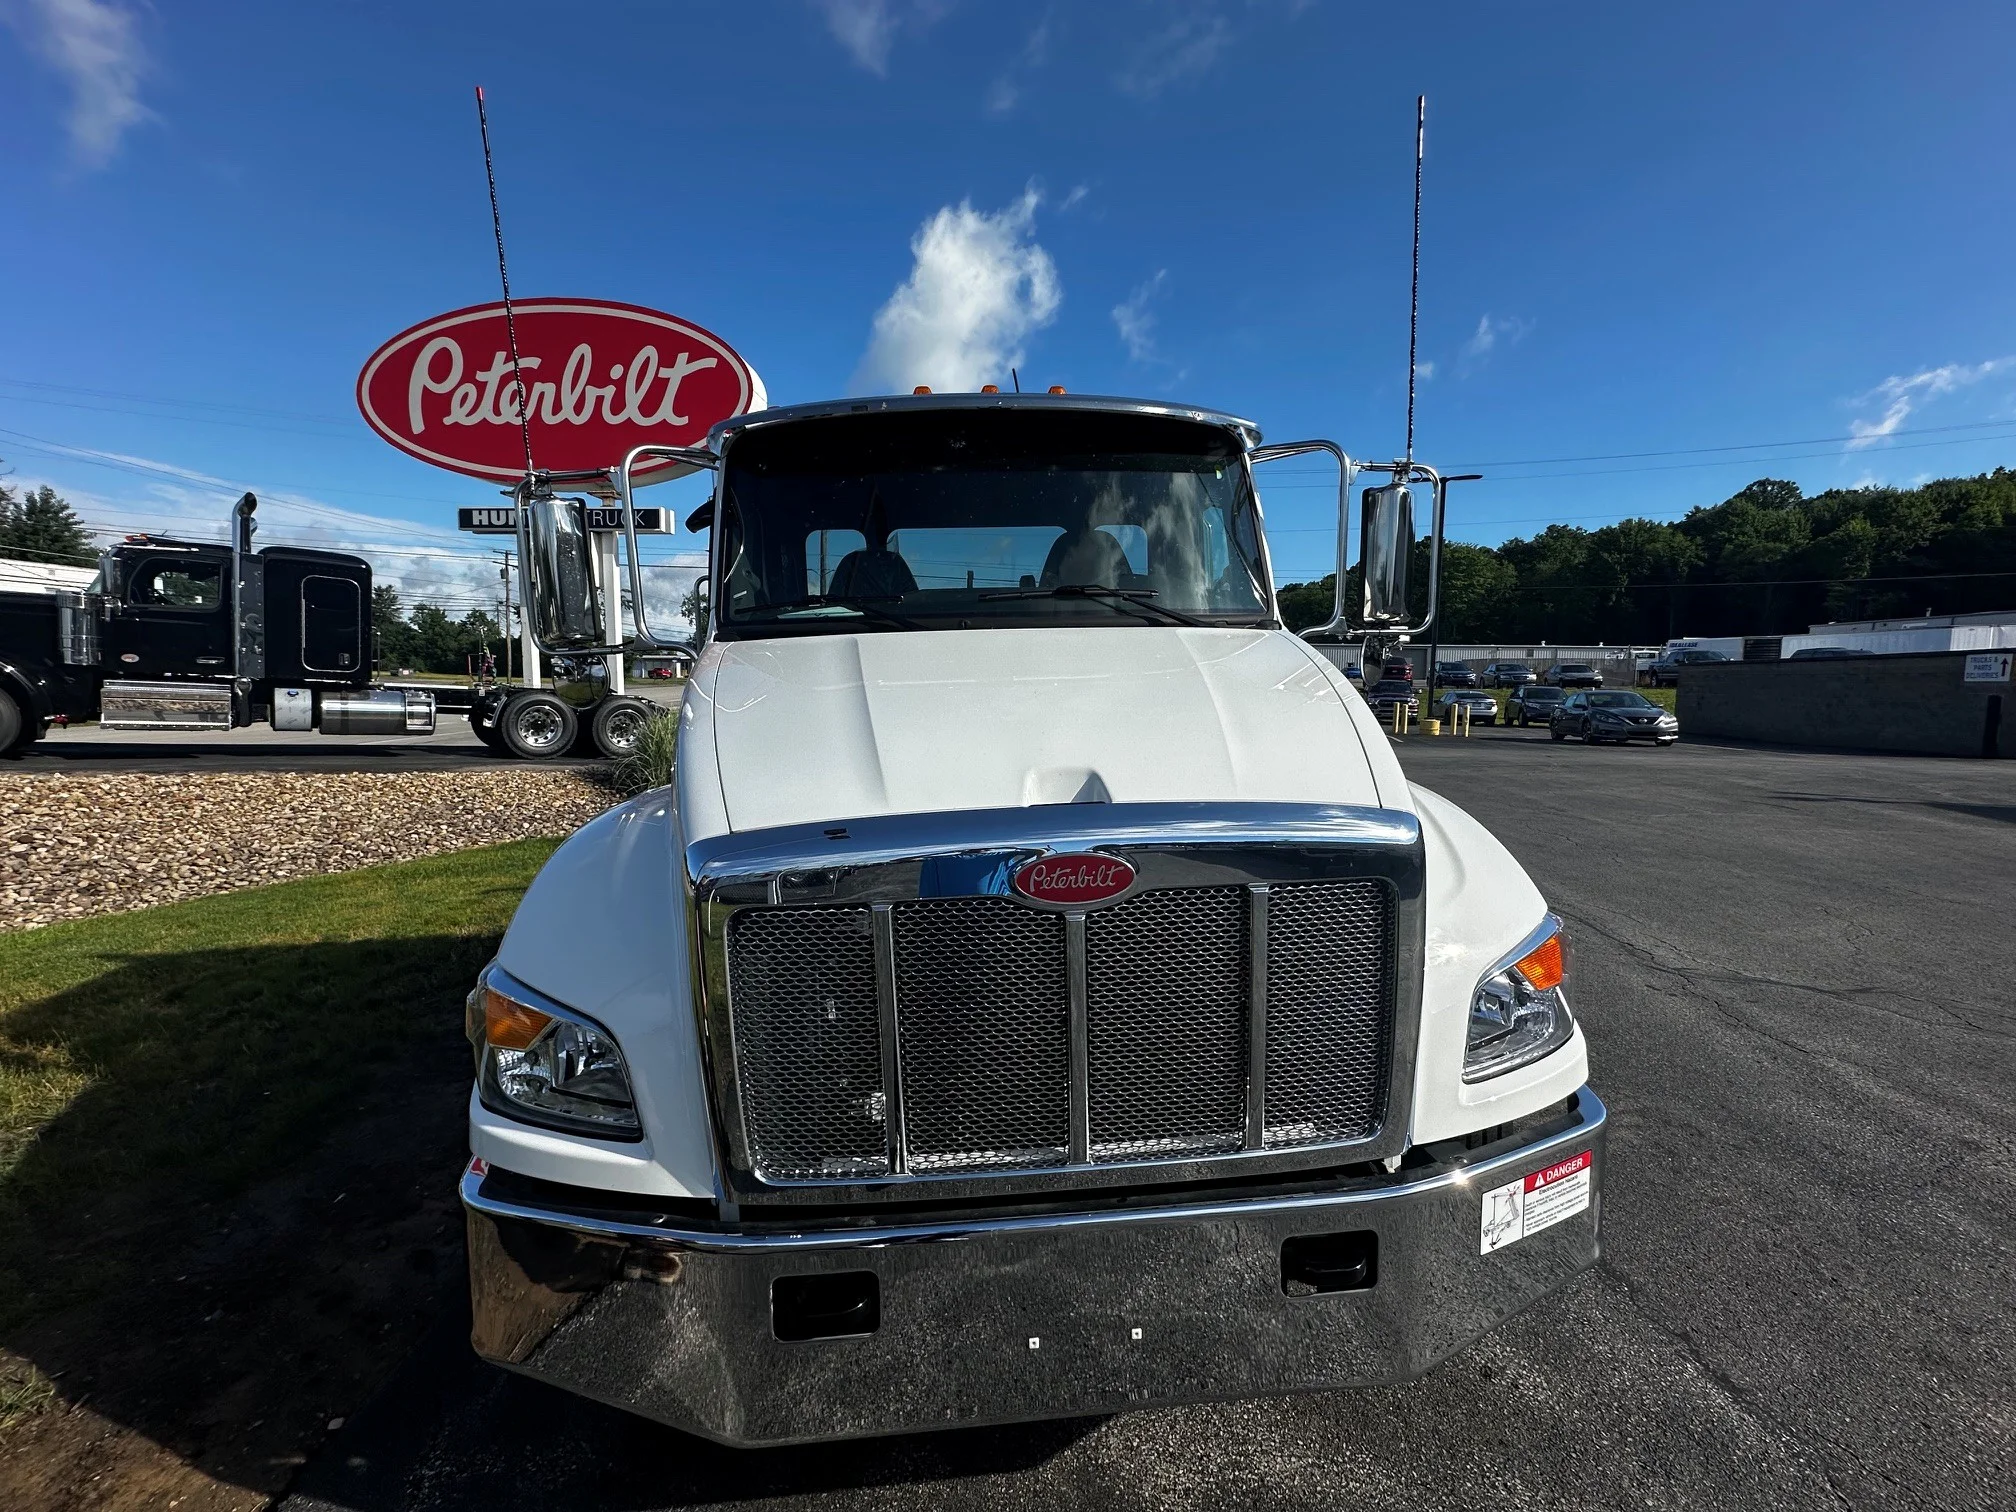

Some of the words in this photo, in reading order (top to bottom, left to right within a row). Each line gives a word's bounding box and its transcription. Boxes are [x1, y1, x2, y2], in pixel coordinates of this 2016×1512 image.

[408, 336, 718, 435] Peterbilt
[472, 510, 526, 525] HUN
[587, 510, 645, 526] RUK
[1029, 864, 1125, 893] Peterbilt
[1546, 1157, 1583, 1181] DANGER
